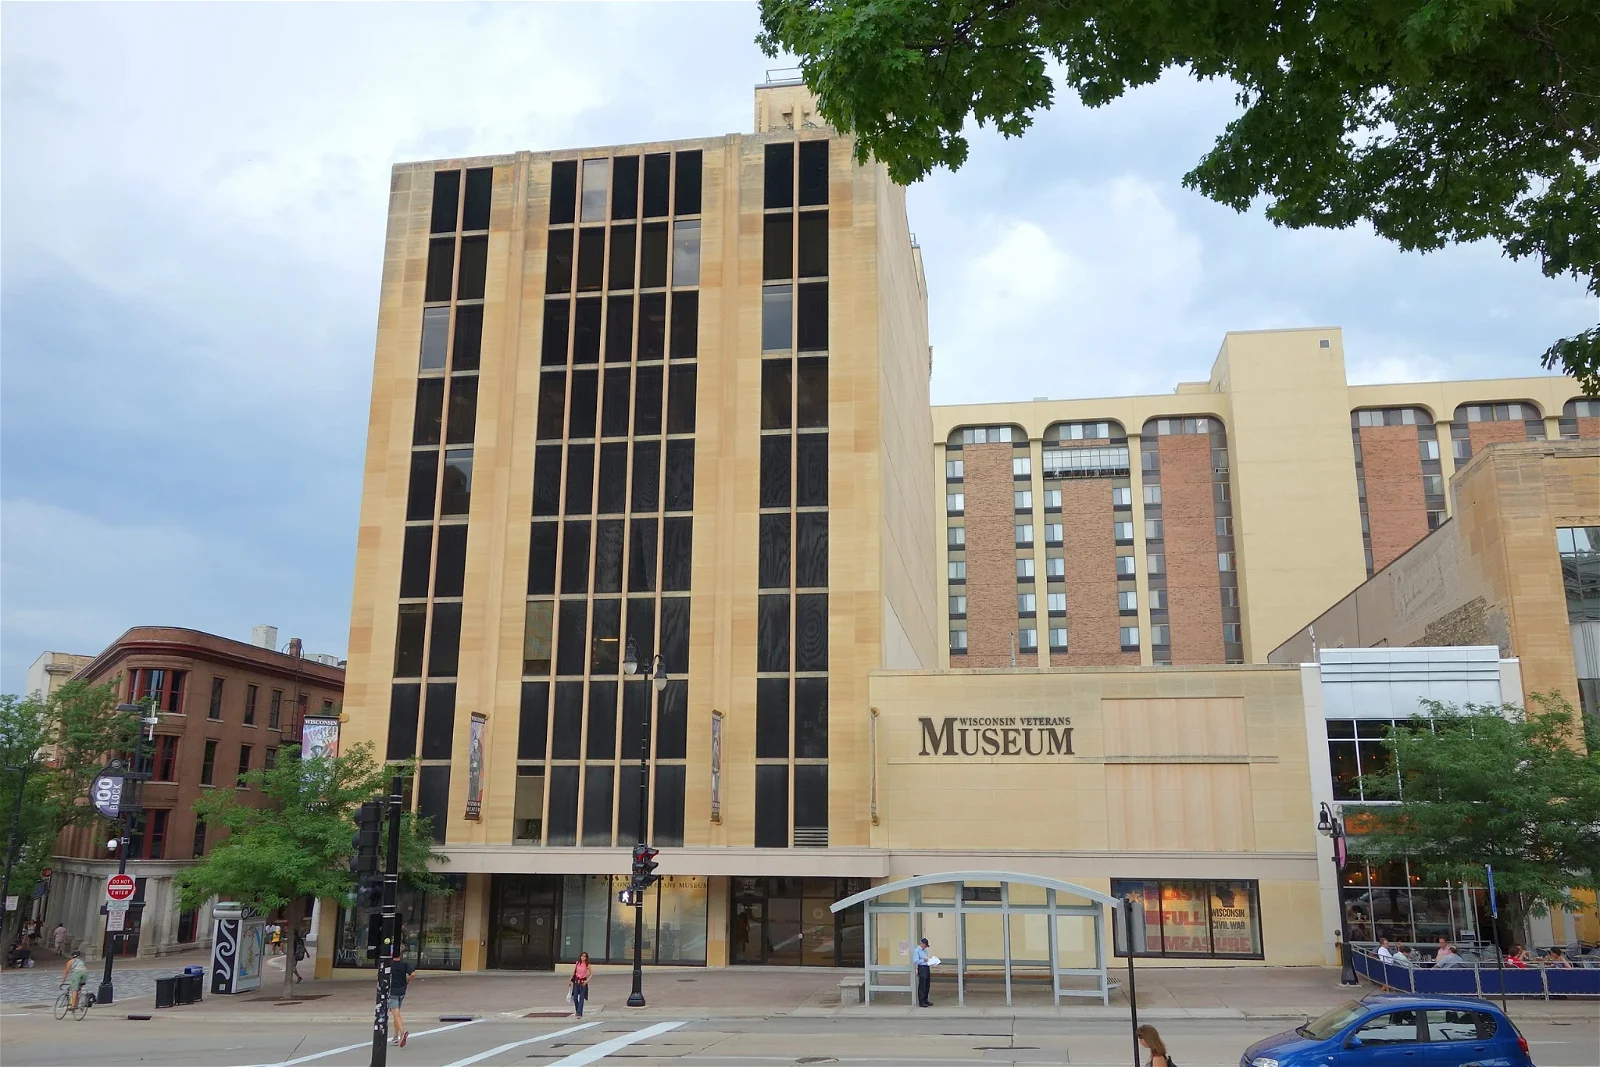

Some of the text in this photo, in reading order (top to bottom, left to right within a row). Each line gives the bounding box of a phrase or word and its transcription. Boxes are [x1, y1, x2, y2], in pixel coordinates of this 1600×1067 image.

[959, 717, 1071, 726] WISCONSIN VETERANS
[918, 717, 1075, 756] MUSEUM
[95, 778, 113, 809] 100
[109, 783, 122, 810] BLOCK
[1163, 911, 1206, 925] FULL
[1211, 908, 1245, 918] WISCONSIN
[1211, 920, 1246, 930] CIVIL WAR
[1165, 936, 1251, 952] MEASURE
